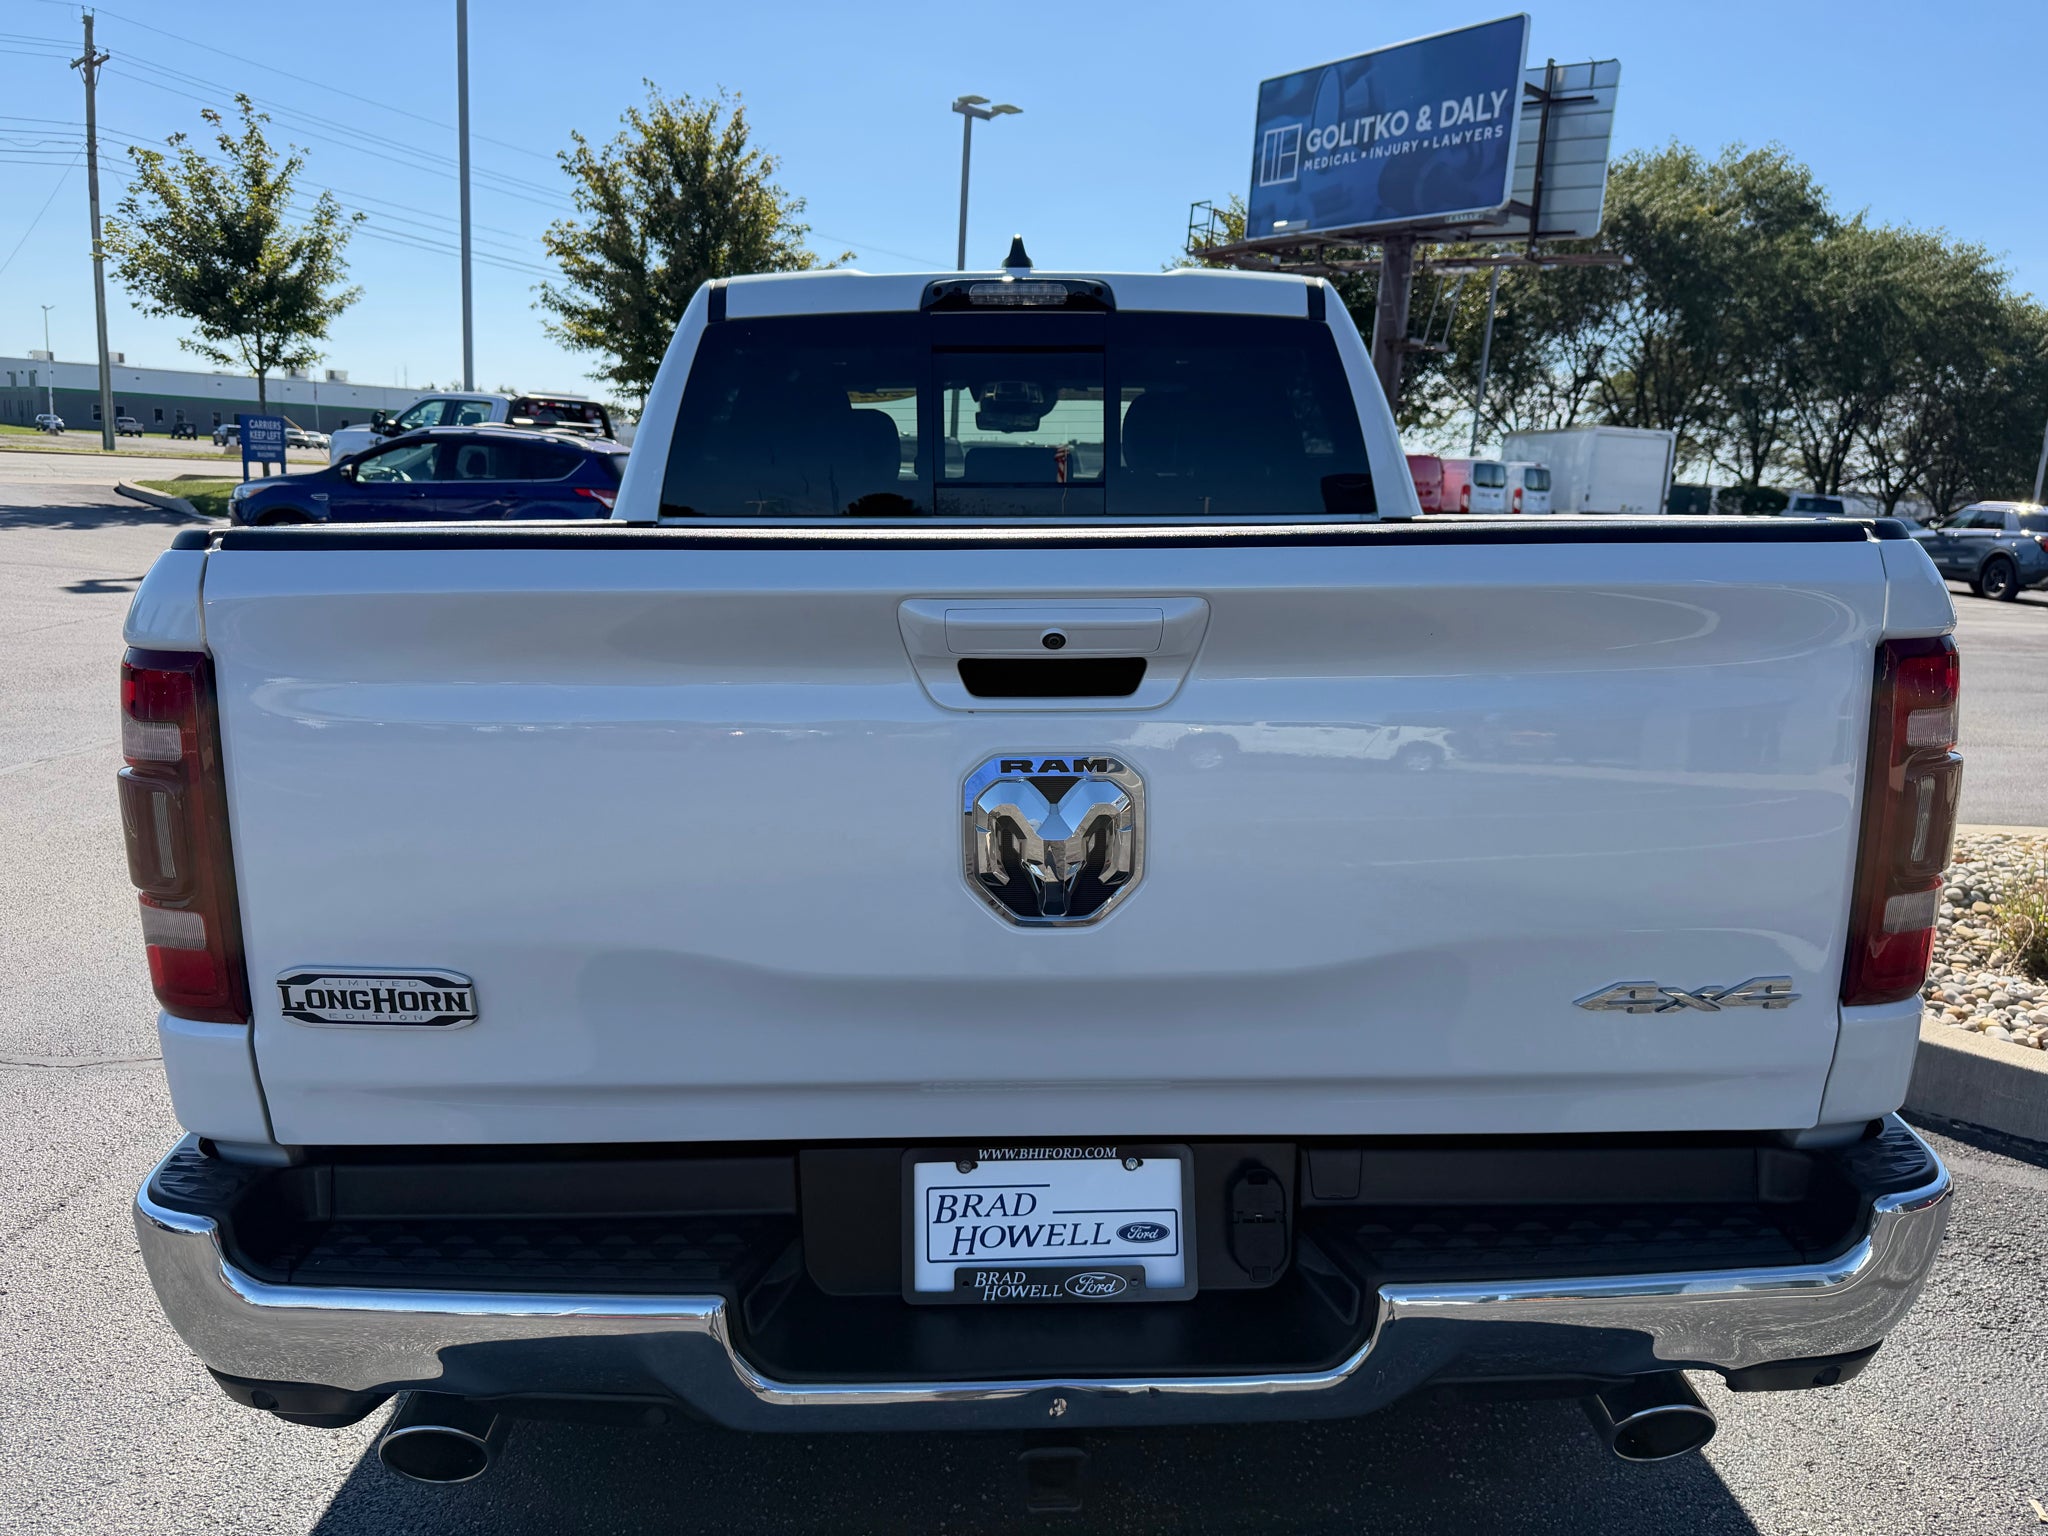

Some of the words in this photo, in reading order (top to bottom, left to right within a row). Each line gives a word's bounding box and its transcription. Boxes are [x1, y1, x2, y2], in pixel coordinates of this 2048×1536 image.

[1306, 110, 1409, 153] GOLITKO
[1415, 104, 1432, 132] &
[1440, 88, 1508, 128] DALY
[1304, 151, 1358, 171] MEDICAL
[1369, 140, 1419, 159] INJURY
[1432, 124, 1504, 149] LAWYERS
[249, 419, 282, 431] CARRIERS
[249, 430, 266, 440] KEEP
[266, 431, 281, 440] LEFT
[1000, 759, 1108, 774] RAM
[322, 979, 418, 988] LIMITED
[328, 1012, 423, 1021] EDITION
[978, 1147, 1117, 1160] WWW.BHIFORD.COM
[932, 1192, 1037, 1224] BRAD
[949, 1222, 1112, 1256] HOWELL
[1126, 1225, 1159, 1240] Ford
[974, 1271, 1026, 1288] BRAD
[982, 1284, 1063, 1301] HOWELL
[1074, 1275, 1117, 1294] Ford
